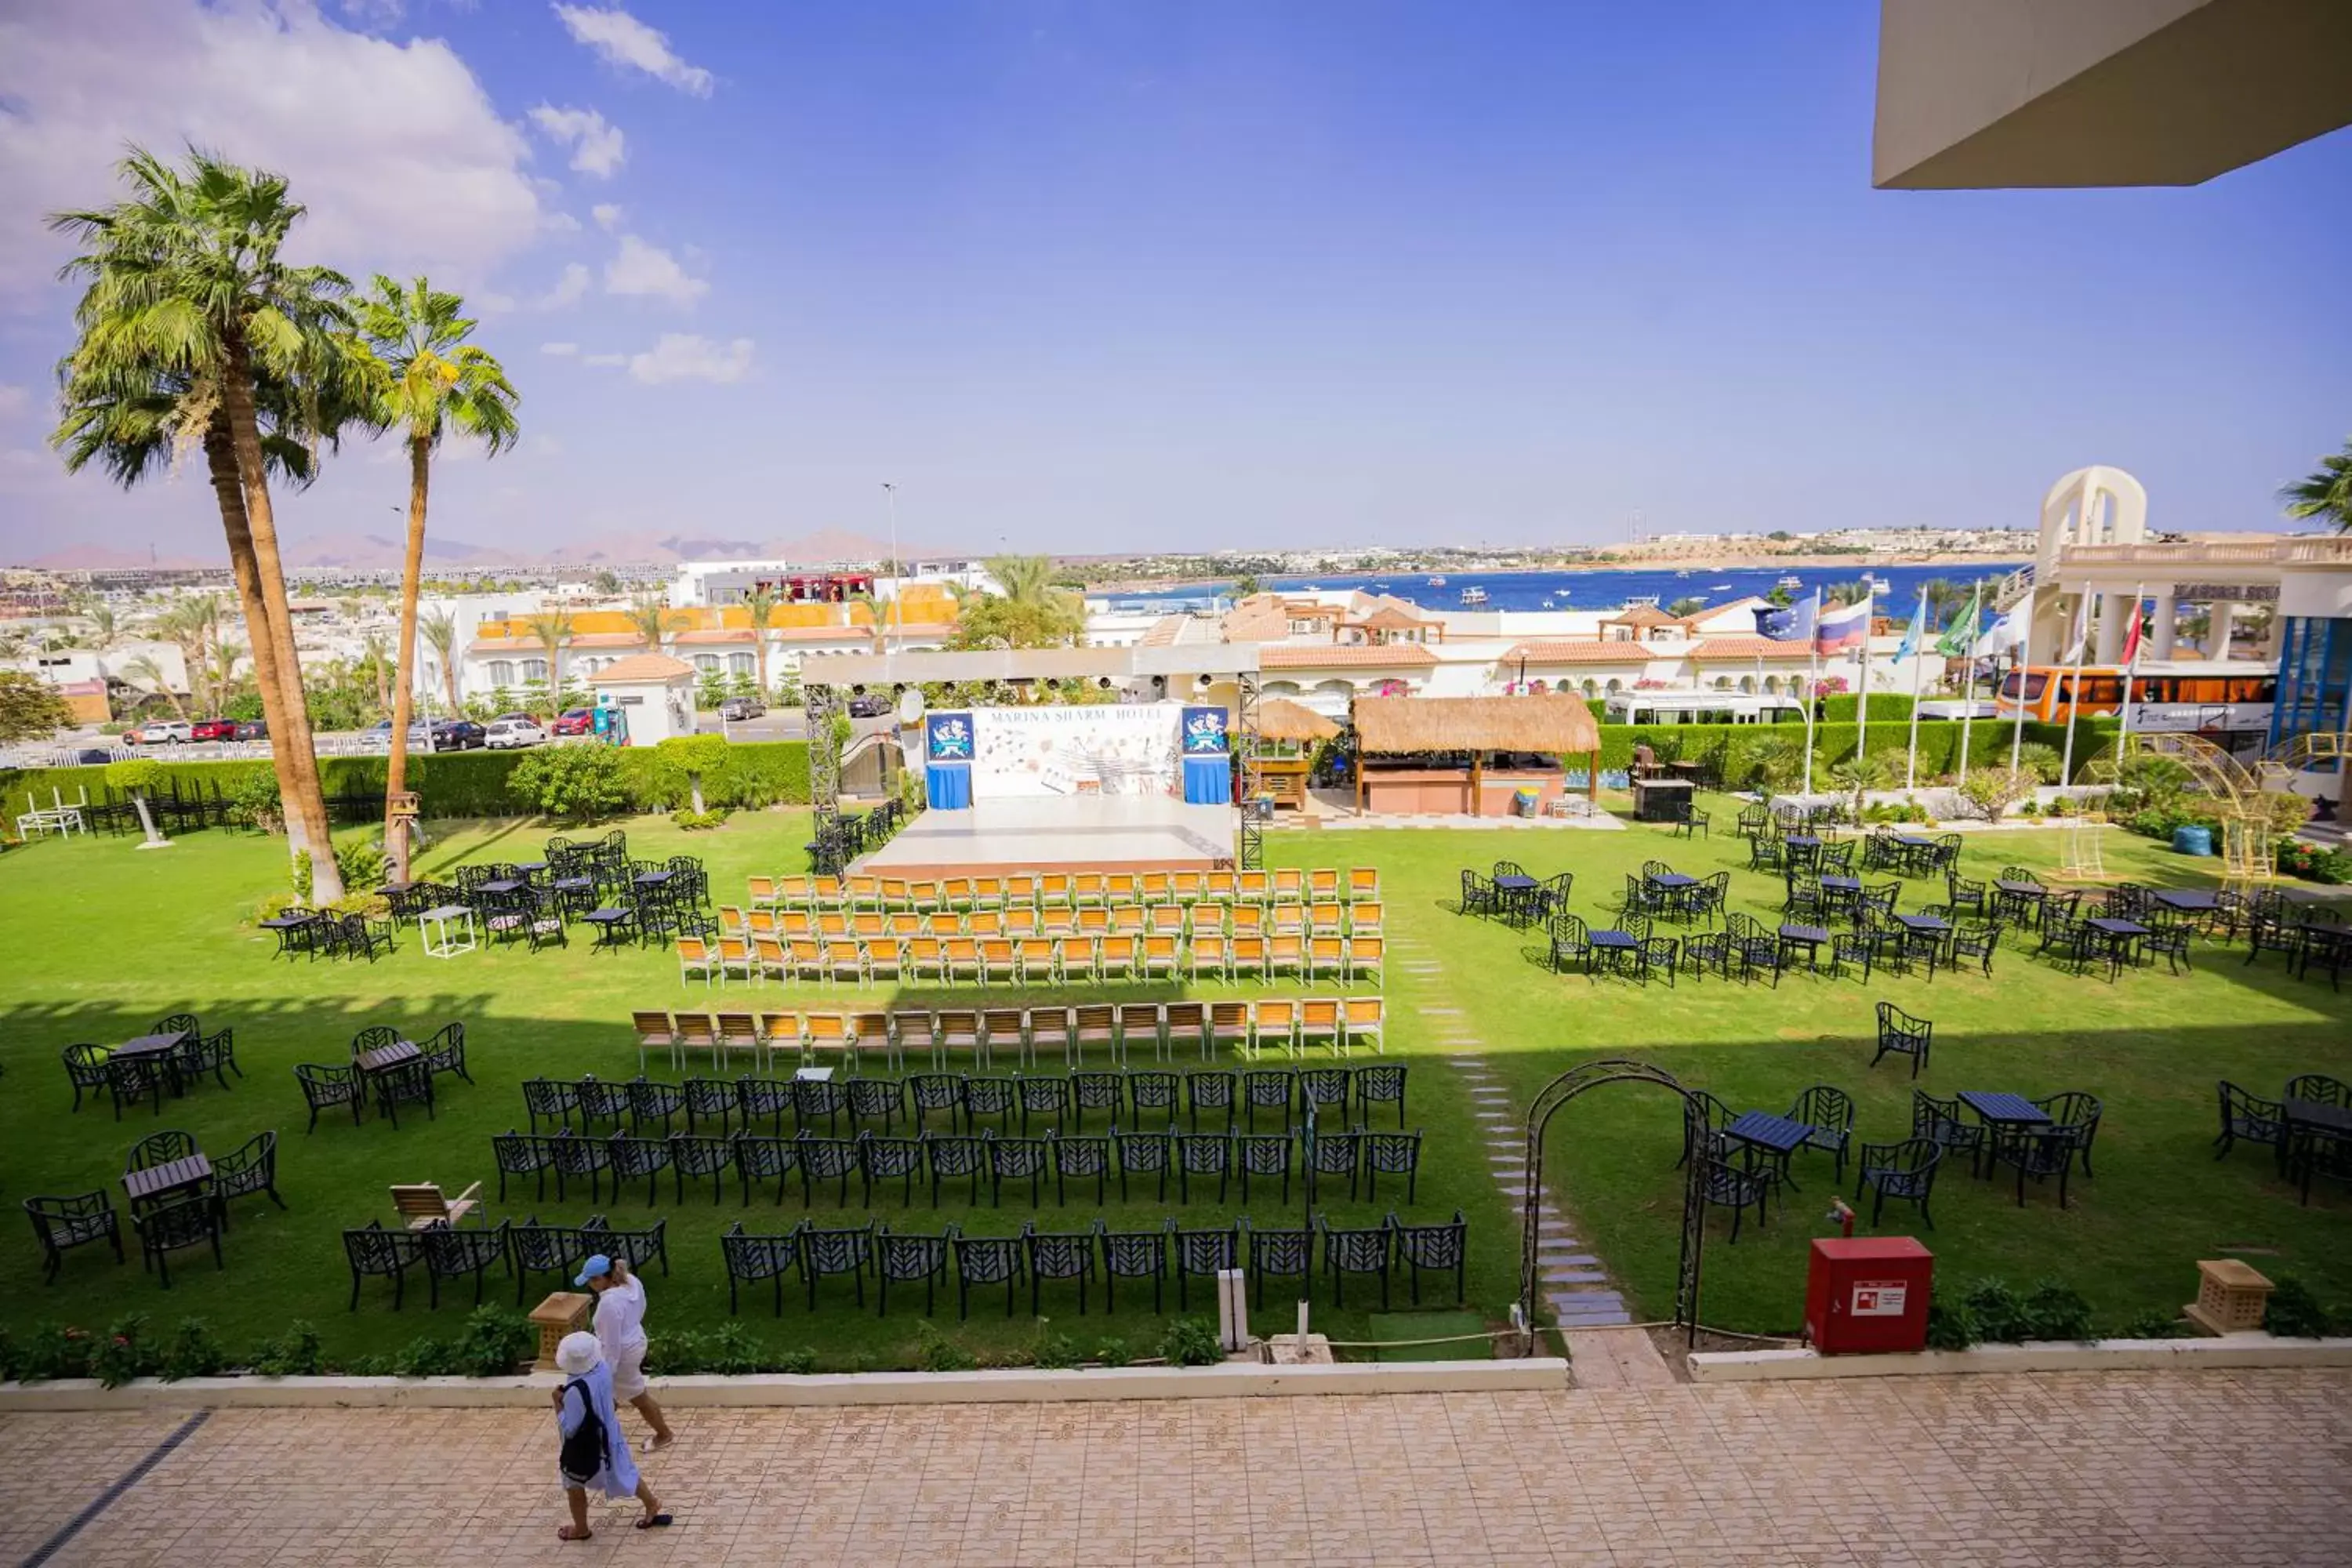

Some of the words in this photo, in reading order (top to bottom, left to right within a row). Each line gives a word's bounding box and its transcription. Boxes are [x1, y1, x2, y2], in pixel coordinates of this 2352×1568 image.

[992, 711, 1050, 723] MARINA
[1054, 710, 1105, 722] SHARM
[1116, 708, 1162, 720] HOTEL
